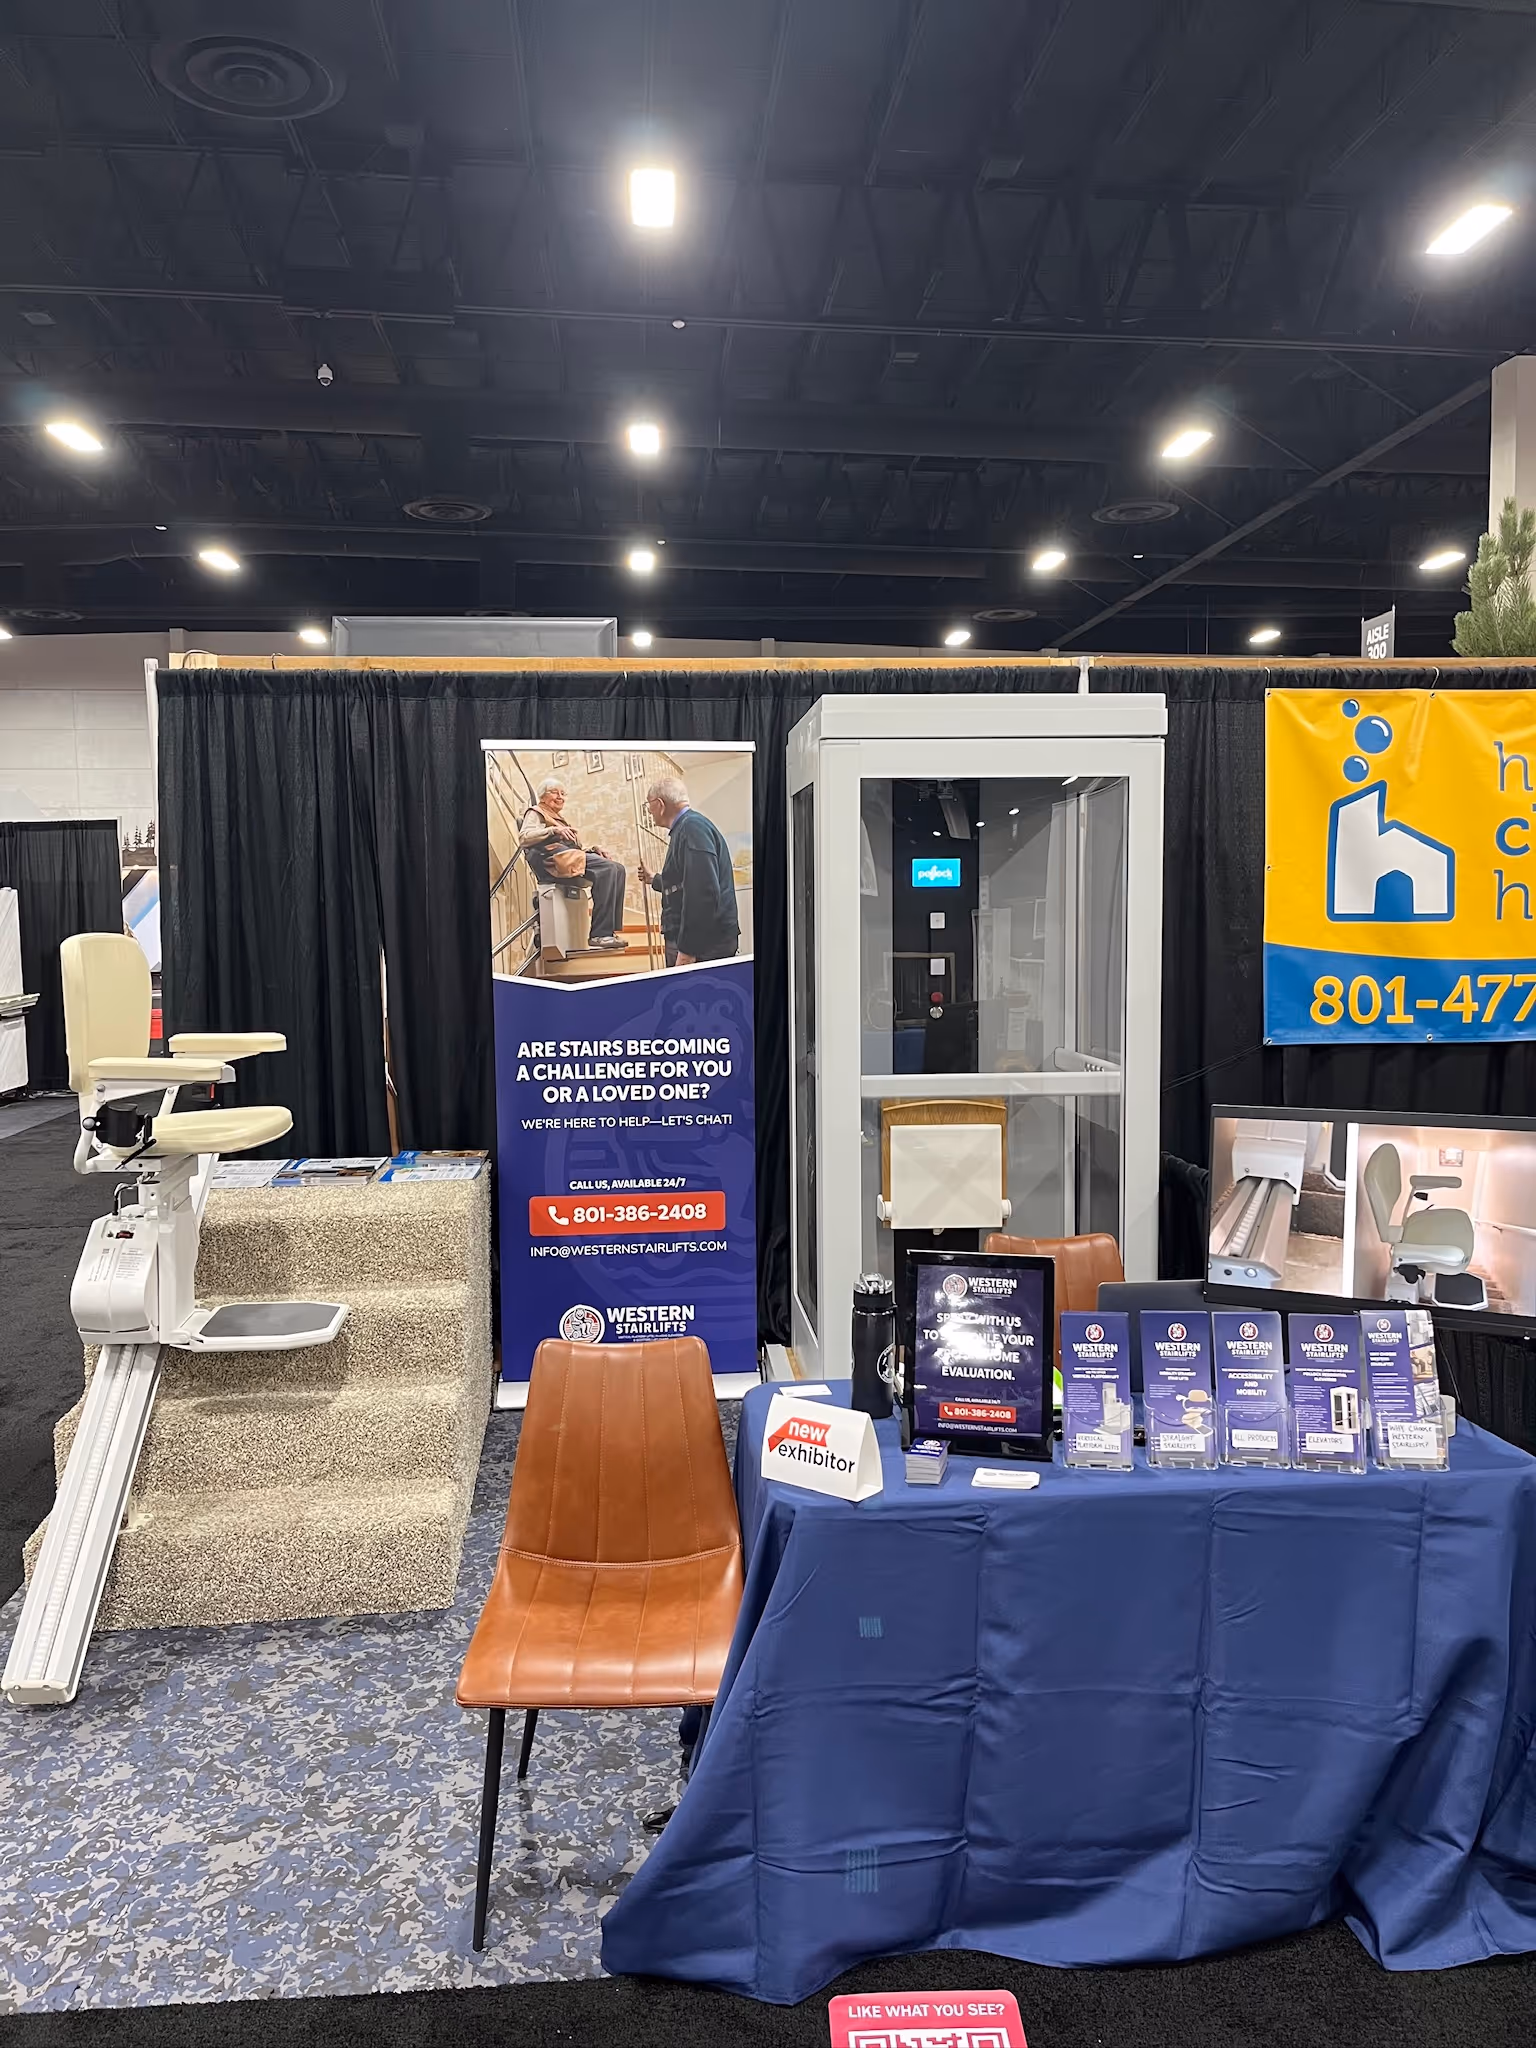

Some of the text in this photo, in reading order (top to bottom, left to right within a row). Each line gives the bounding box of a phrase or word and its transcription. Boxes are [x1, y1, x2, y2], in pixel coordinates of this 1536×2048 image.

[1366, 622, 1390, 646] AISLE
[1494, 804, 1536, 857] c
[1309, 973, 1536, 1025] 801-477
[517, 1038, 730, 1059] ARE STAIRS BECOMING
[516, 1060, 732, 1082] A CHALLENGE FOR YOU
[542, 1083, 711, 1103] OR A LOVED ONE?
[521, 1118, 561, 1130] WE'RE
[564, 1117, 596, 1129] HERE
[599, 1117, 617, 1128] TO
[695, 1114, 733, 1126] CHAT!
[569, 1177, 686, 1192] CALL US, AVAILABLE 24/7
[573, 1203, 707, 1223] 801-386-2408
[530, 1240, 727, 1258] INFO@WESTERNSTAIRLIFTS.COM
[968, 1277, 1018, 1288] WESTERN
[972, 1286, 1013, 1295] STAIRLIFTS
[606, 1305, 695, 1323] WESTERN
[615, 1321, 687, 1334] STAIRLIFTS
[1006, 1316, 1022, 1328] US
[923, 1329, 939, 1340] TO
[1001, 1334, 1035, 1347] YOUR
[1367, 1332, 1403, 1340] WESTERN
[1072, 1343, 1118, 1352] WESTERN
[1154, 1341, 1201, 1351] WESTERN
[1226, 1340, 1273, 1350] WESTERN
[1300, 1343, 1349, 1353] WESTERN
[941, 1366, 1016, 1381] EVALUATION.
[1228, 1372, 1273, 1380] ACCESSIBILITY
[954, 1407, 1012, 1419] 801-386-2408
[788, 1420, 827, 1442] new
[1162, 1434, 1193, 1442] STRAIGHT
[1247, 1434, 1277, 1443] PRODUCTS
[1308, 1436, 1343, 1444] ELEVATORS
[778, 1443, 856, 1474] exhibitor
[848, 2003, 1005, 2018] LIKE WHAT YOU SEE?
